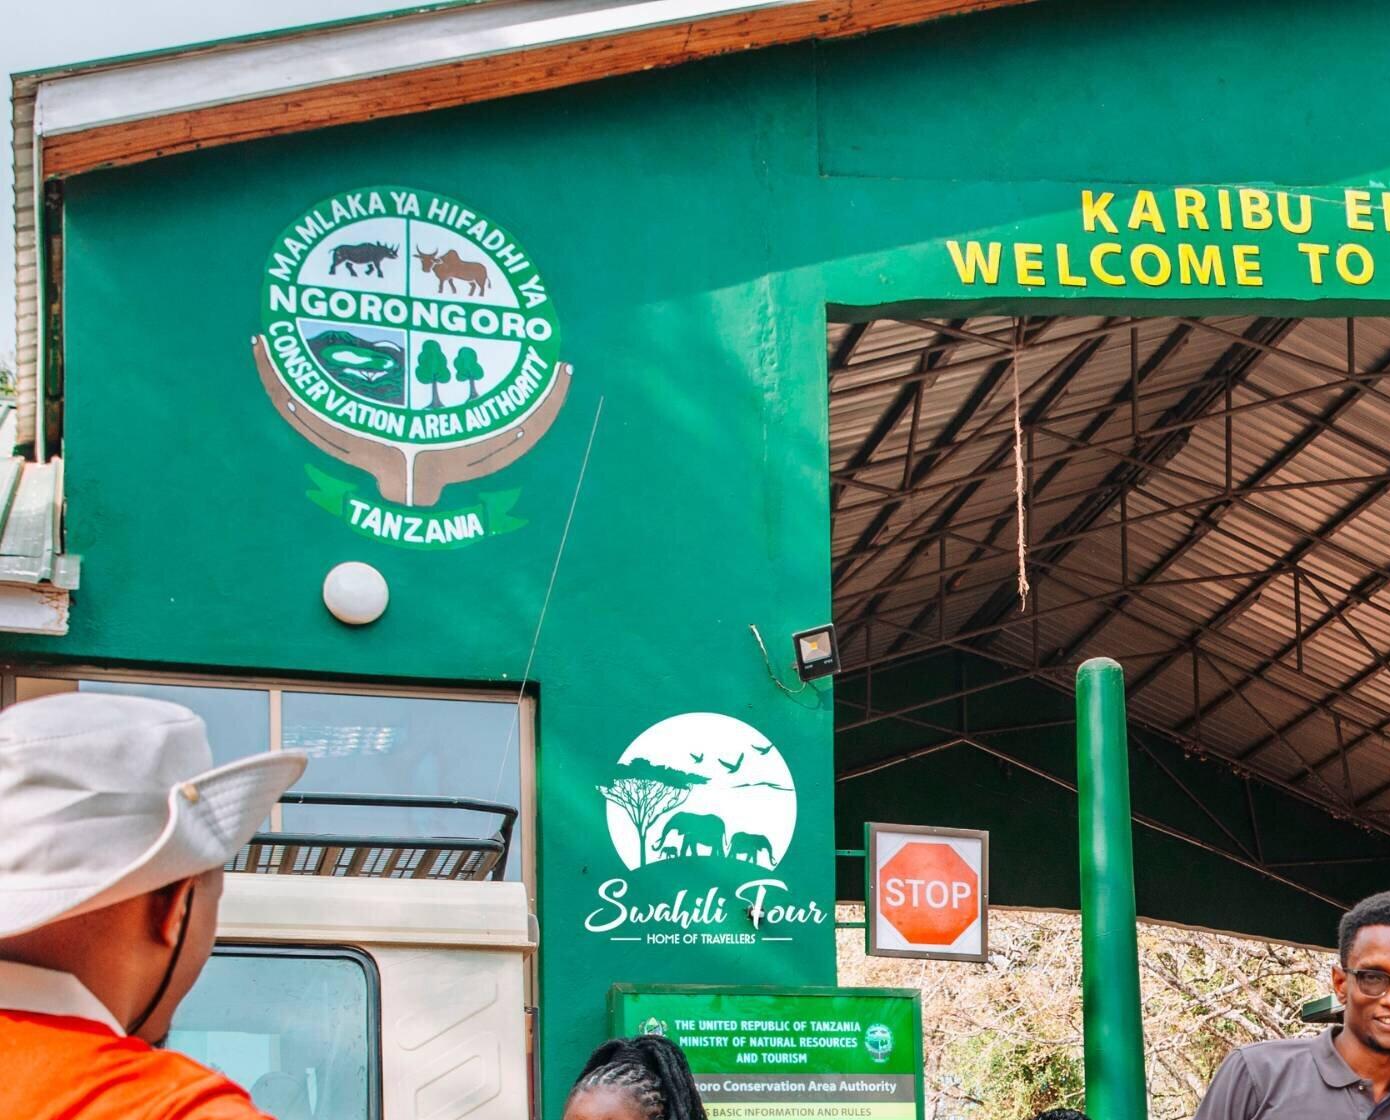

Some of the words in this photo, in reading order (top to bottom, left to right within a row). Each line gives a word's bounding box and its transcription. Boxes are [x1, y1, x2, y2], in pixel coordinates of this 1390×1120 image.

[1081, 189, 1313, 234] KARIBU
[269, 191, 386, 281] MAMLAKA
[391, 191, 420, 217] YA
[428, 198, 529, 282] HIFADHI
[517, 278, 547, 309] YA
[947, 240, 1264, 287] WELCOME
[1299, 243, 1375, 286] TO
[270, 284, 552, 342] NGORONGORO
[269, 320, 405, 438] CONSERVATION
[409, 408, 464, 440] AREA
[465, 346, 549, 424] AUTHORITY
[349, 499, 485, 543] TANZANIA
[885, 879, 972, 909] STOP
[675, 1020, 697, 1030] THE
[699, 1020, 737, 1031] UNITED
[741, 1020, 790, 1031] REPUBLIC
[793, 1021, 807, 1031] OF
[810, 1021, 861, 1032] TANZANIA
[679, 1036, 728, 1047] MINISTRY
[732, 1037, 746, 1047] OF
[749, 1037, 796, 1047] NATURAL
[799, 1037, 858, 1048] RESOURCES
[736, 1053, 758, 1063] AND
[762, 1053, 807, 1064] TOURISM
[723, 1080, 805, 1092] Conservation
[808, 1081, 837, 1092] Area
[839, 1080, 897, 1094] Authority
[713, 1108, 742, 1117] BASIC
[745, 1107, 814, 1117] INFORMATION
[817, 1108, 838, 1116] AND
[841, 1108, 871, 1116] RULES
